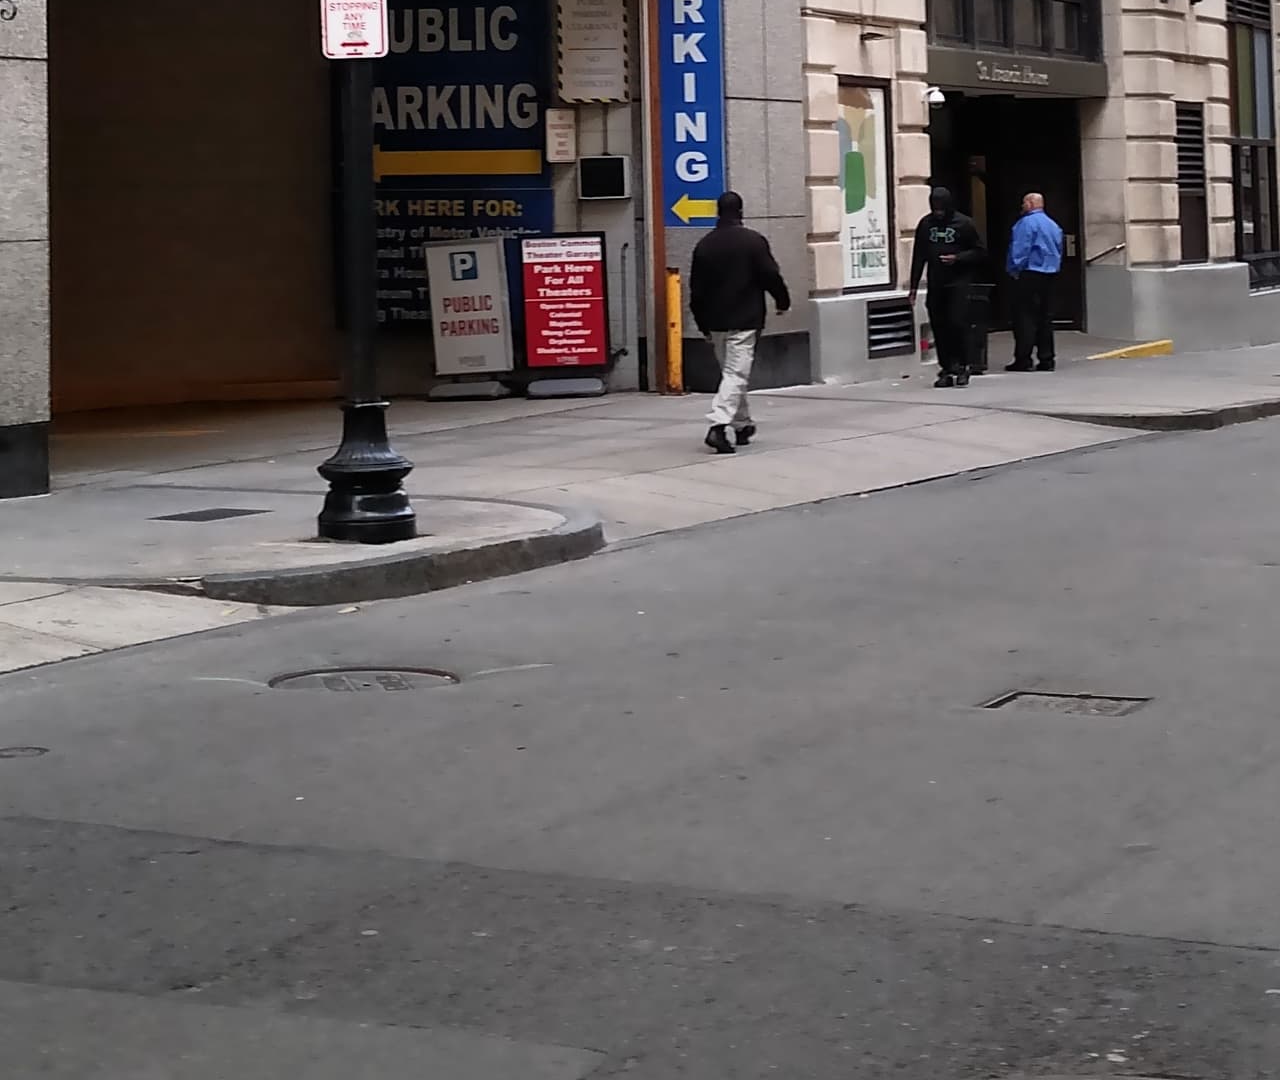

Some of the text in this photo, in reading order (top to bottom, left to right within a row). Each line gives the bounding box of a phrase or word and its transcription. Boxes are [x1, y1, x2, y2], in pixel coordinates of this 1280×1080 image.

[329, 2, 378, 11] STOPPING
[342, 22, 367, 30] TIME
[389, 6, 518, 53] UBLIC
[373, 83, 538, 130] ARKING
[407, 199, 465, 216] HERE
[472, 199, 523, 216] FOR:
[526, 251, 600, 259] Theater Garage
[453, 254, 472, 279] P
[534, 264, 594, 273] Park Here
[544, 275, 584, 285] For All
[537, 288, 592, 297] Theaters
[443, 295, 493, 313] PUBLIC
[440, 319, 499, 336] PARKING
